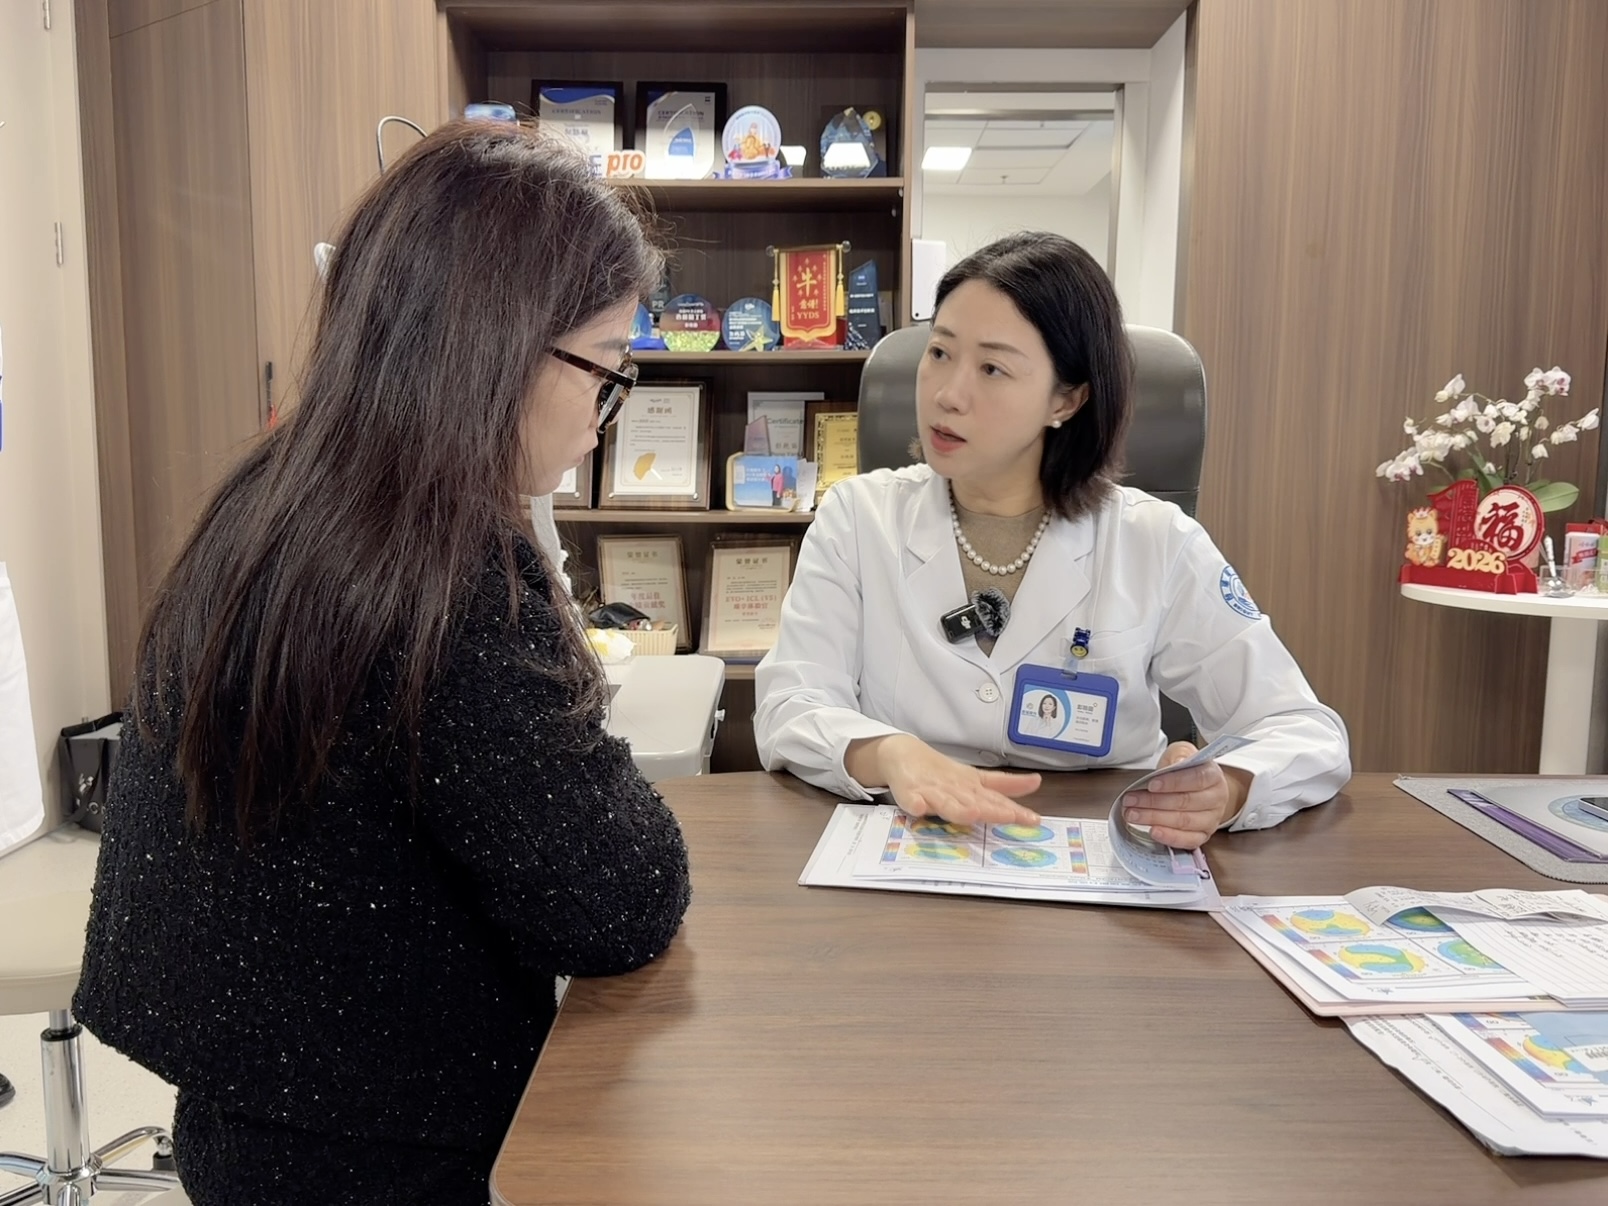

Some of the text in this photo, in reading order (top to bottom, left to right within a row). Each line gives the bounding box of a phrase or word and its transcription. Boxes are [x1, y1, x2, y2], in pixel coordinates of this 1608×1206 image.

[606, 153, 643, 176] pro
[796, 267, 818, 297] 牛
[796, 311, 820, 319] YYDS
[767, 417, 804, 425] Certificate
[1480, 501, 1524, 551] 福
[1447, 547, 1506, 575] 2026
